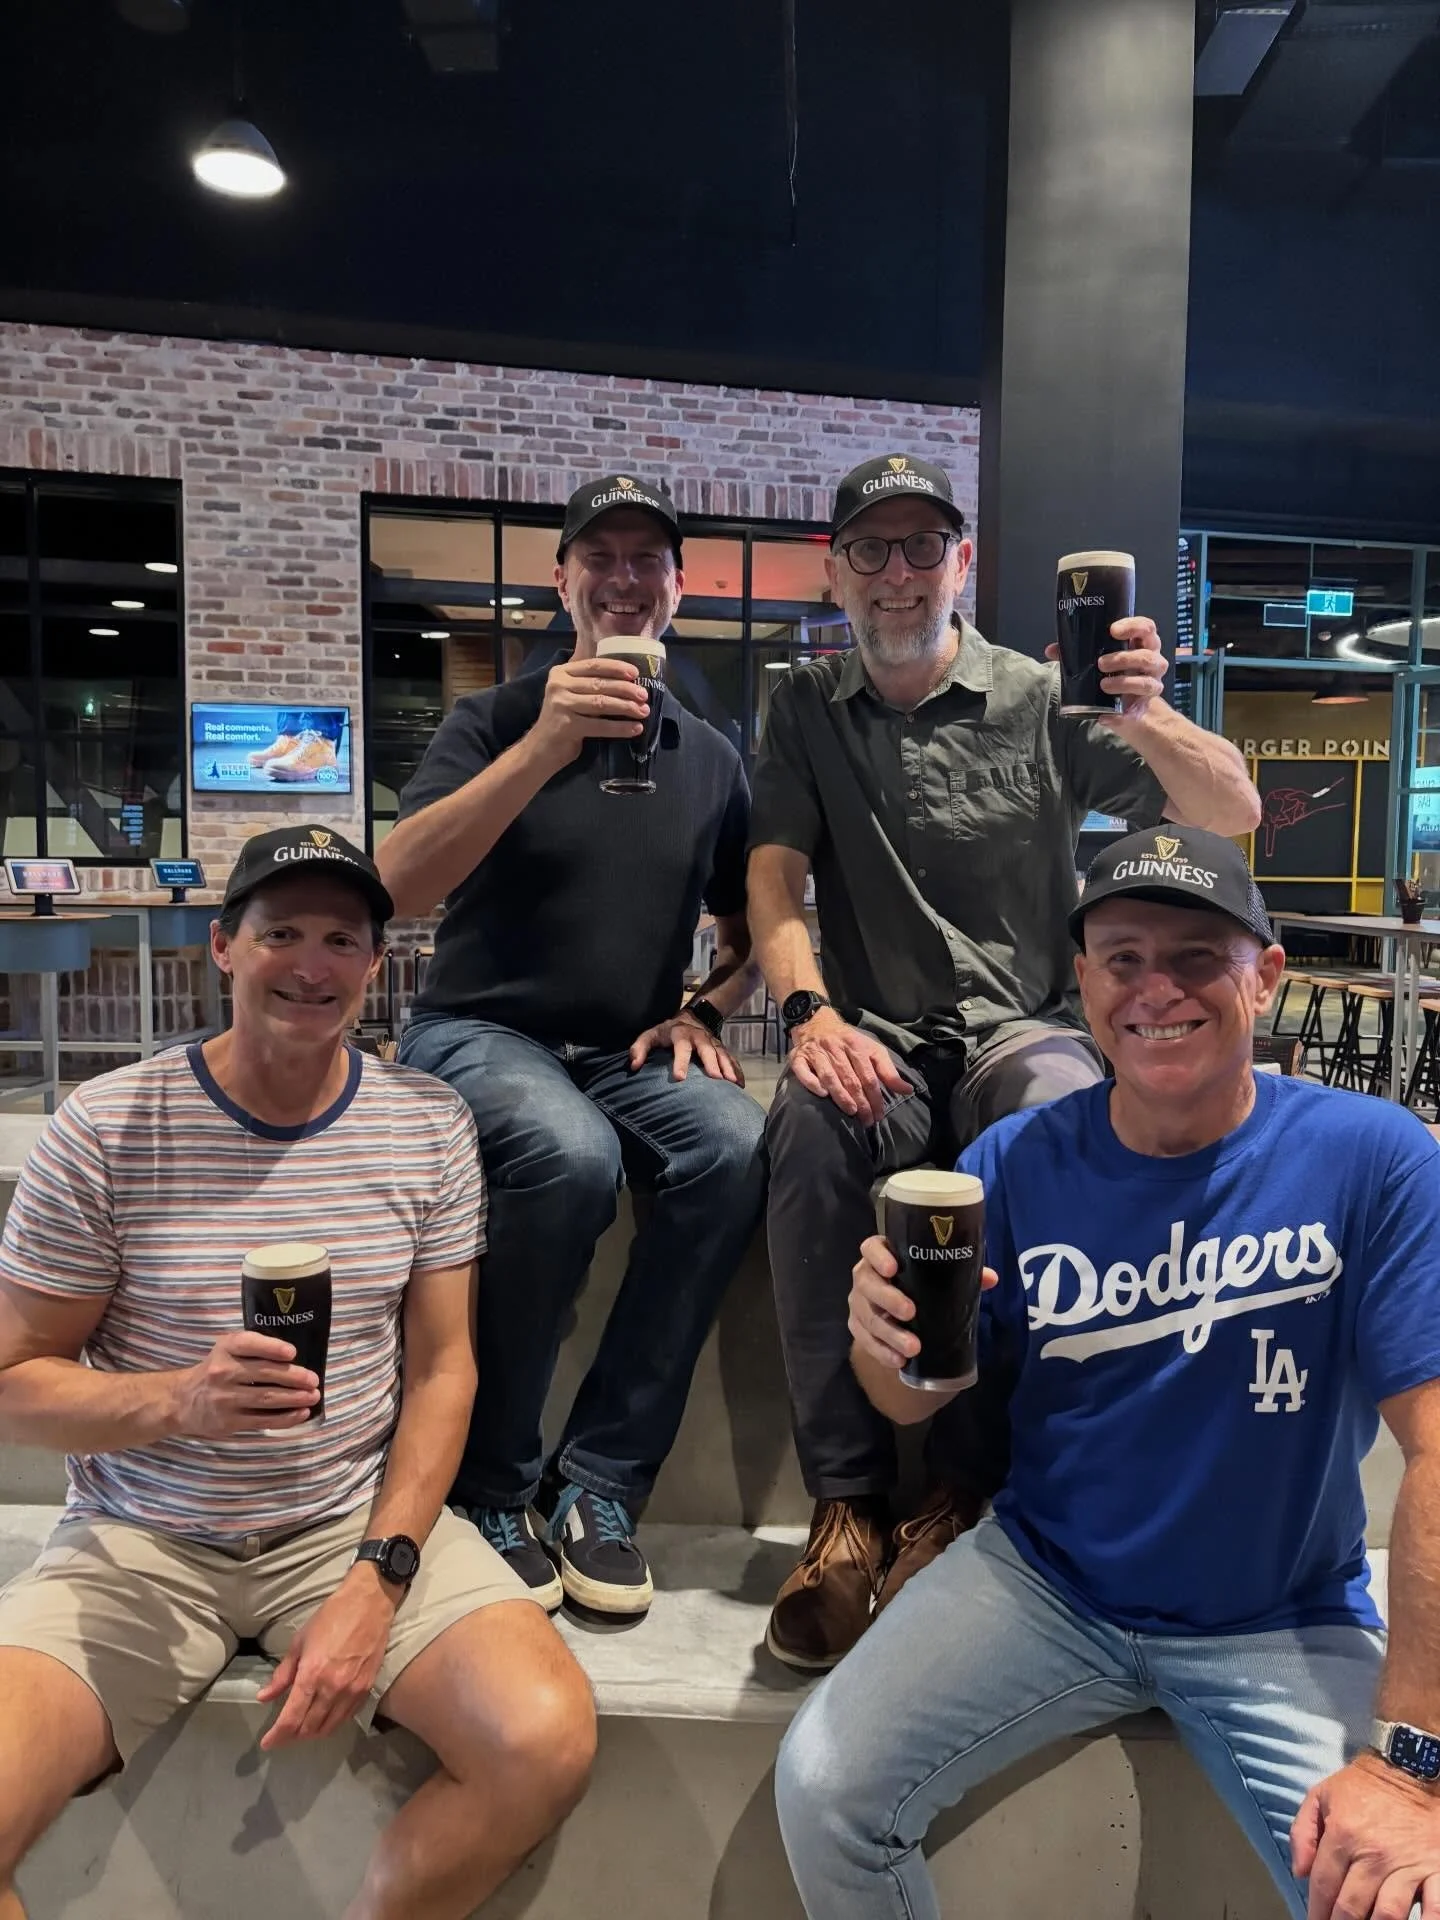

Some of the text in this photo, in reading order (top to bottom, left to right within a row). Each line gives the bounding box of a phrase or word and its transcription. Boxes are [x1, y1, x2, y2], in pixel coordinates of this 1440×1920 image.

[863, 474, 935, 495] GUINNESS
[591, 490, 660, 509] GUINNESS
[1058, 595, 1105, 611] GUINNESS
[204, 722, 272, 733] Real comments.
[204, 732, 261, 741] Real comfort.
[1233, 739, 1311, 757] RGER
[1112, 860, 1219, 889] GUINNESS
[909, 1244, 974, 1261] GUINNESS
[1018, 1220, 1343, 1354] Dodgers
[254, 1310, 314, 1326] GUINNESS
[1249, 1328, 1308, 1413] LA
